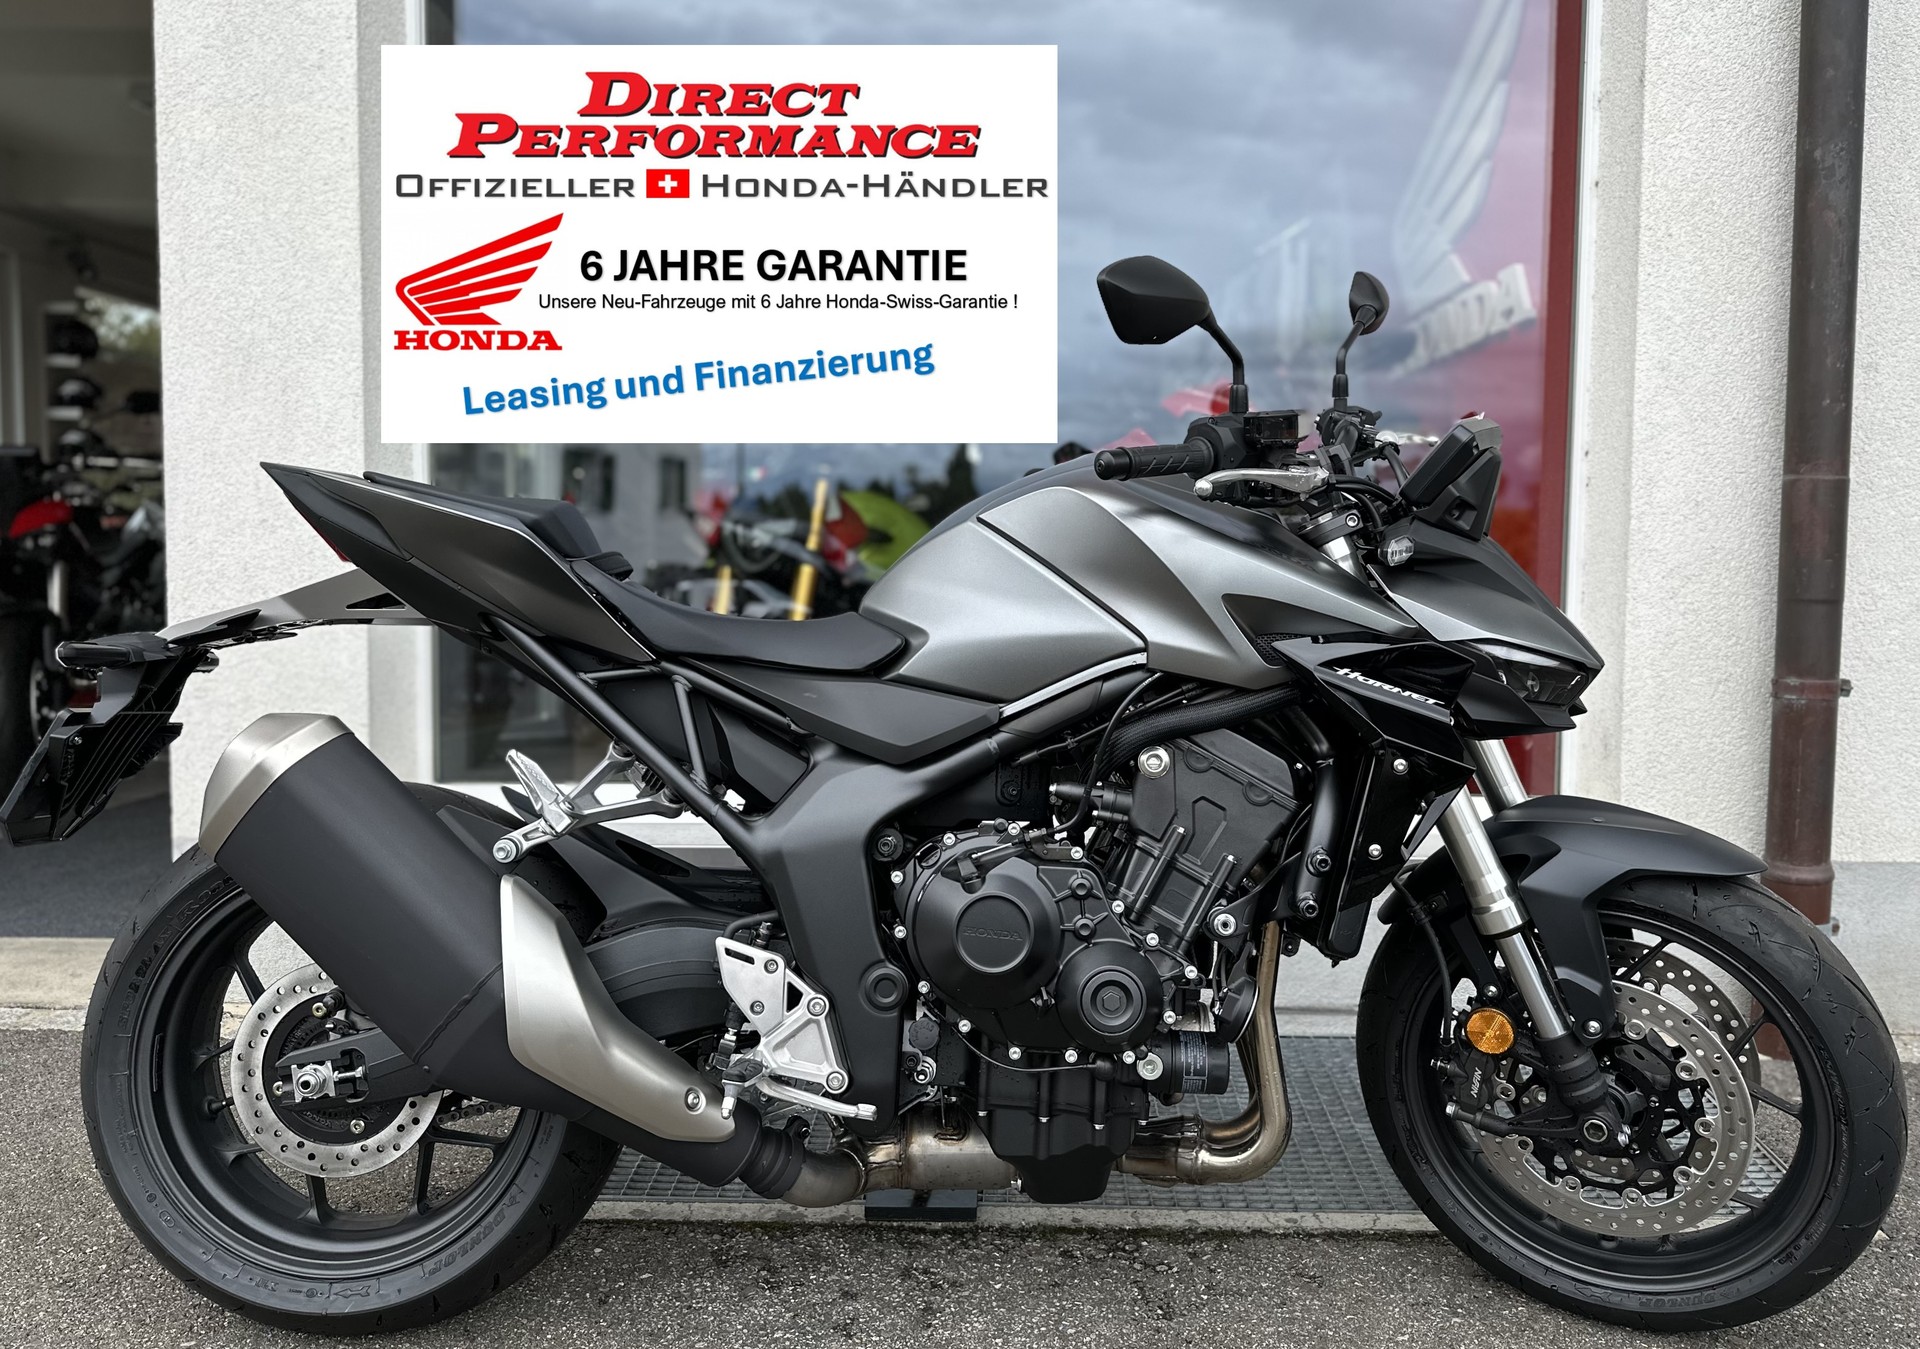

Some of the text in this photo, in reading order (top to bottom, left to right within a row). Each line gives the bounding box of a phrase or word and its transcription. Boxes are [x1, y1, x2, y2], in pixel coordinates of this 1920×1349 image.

[1333, 666, 1445, 704] HORNET
[962, 926, 1023, 941] HONDA
[428, 1207, 506, 1277] DUNLOP
[1638, 1291, 1717, 1308] DUNLOP
